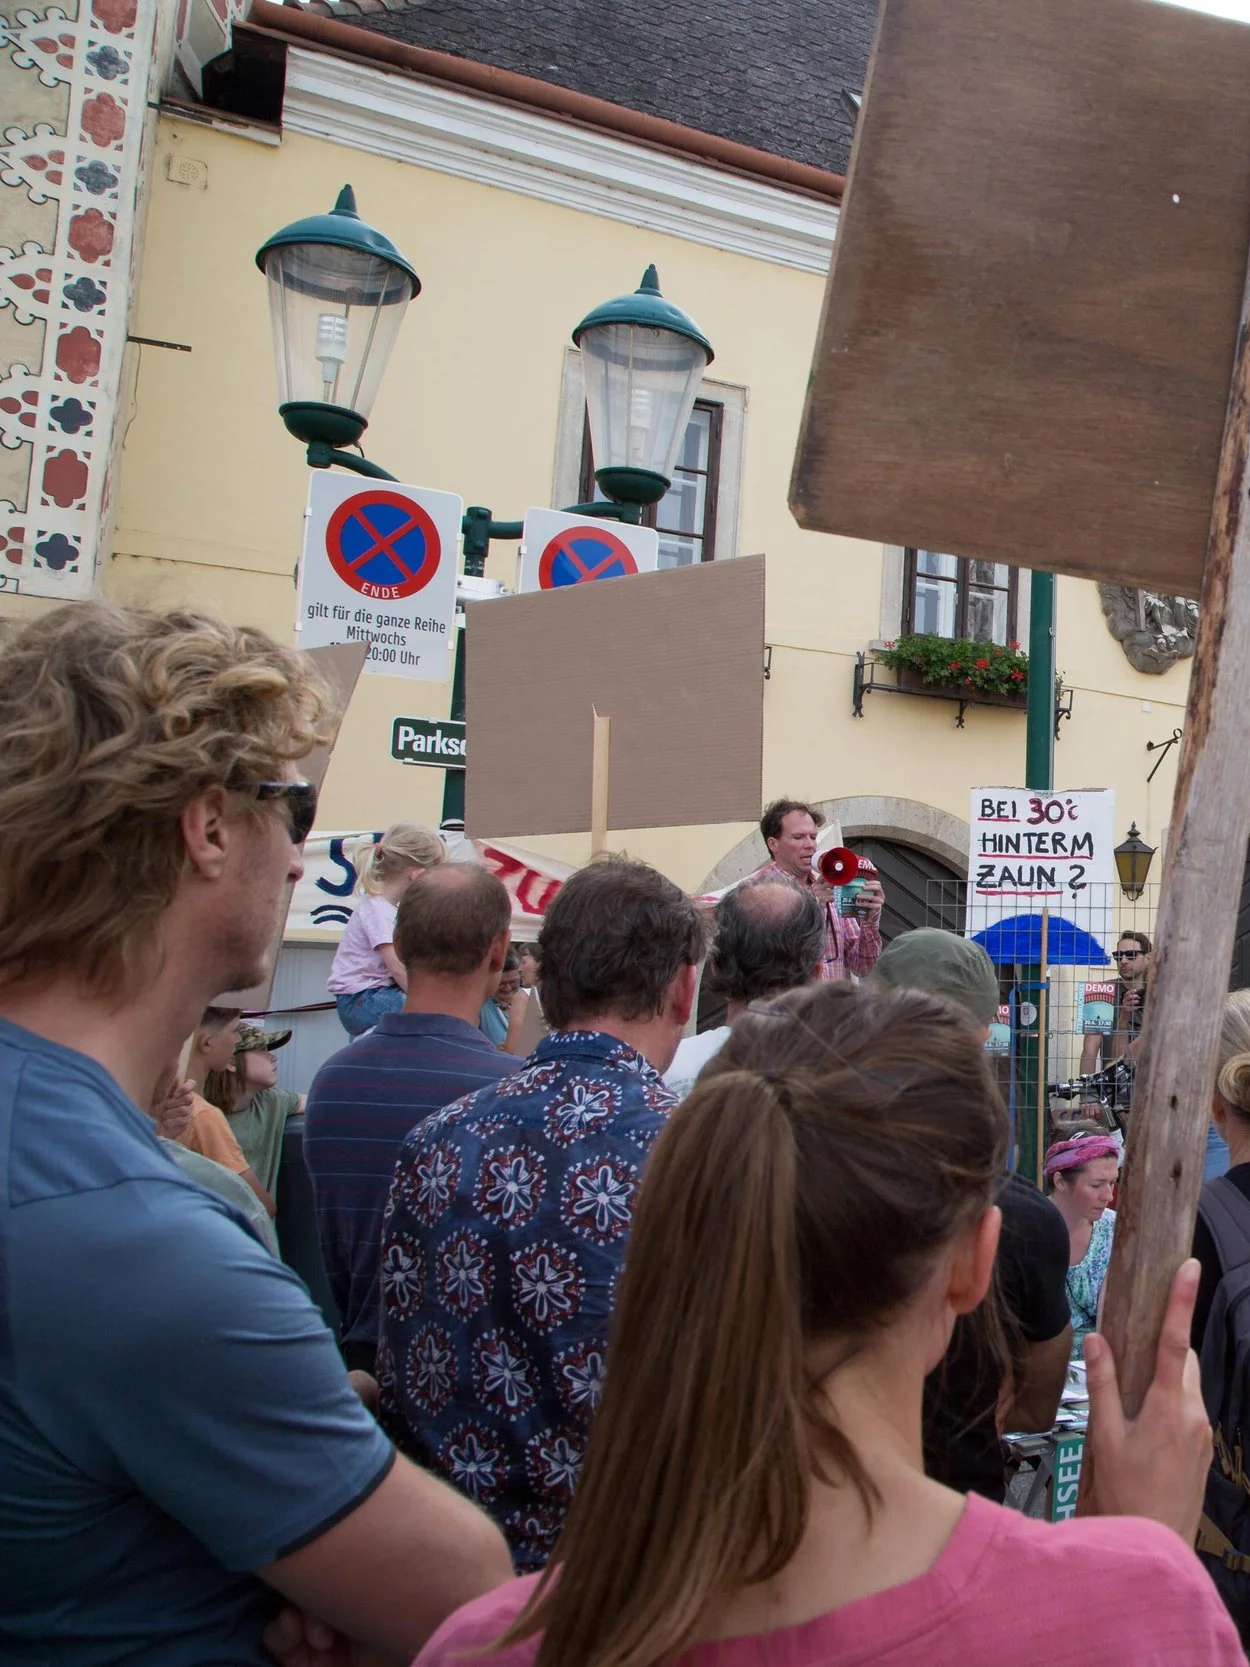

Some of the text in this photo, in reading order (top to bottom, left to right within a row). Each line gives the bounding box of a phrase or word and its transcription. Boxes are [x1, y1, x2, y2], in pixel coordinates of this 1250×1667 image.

[360, 582, 400, 599] ENDE
[307, 602, 446, 634] gilt für die ganze Reihe
[346, 625, 407, 646] Mittwochs
[365, 647, 421, 666] 20:00 Uhr
[980, 798, 1017, 819] BEI
[977, 831, 1094, 857] HINTERM
[976, 863, 1087, 900] ZAUN ?
[1085, 983, 1115, 993] DEMO
